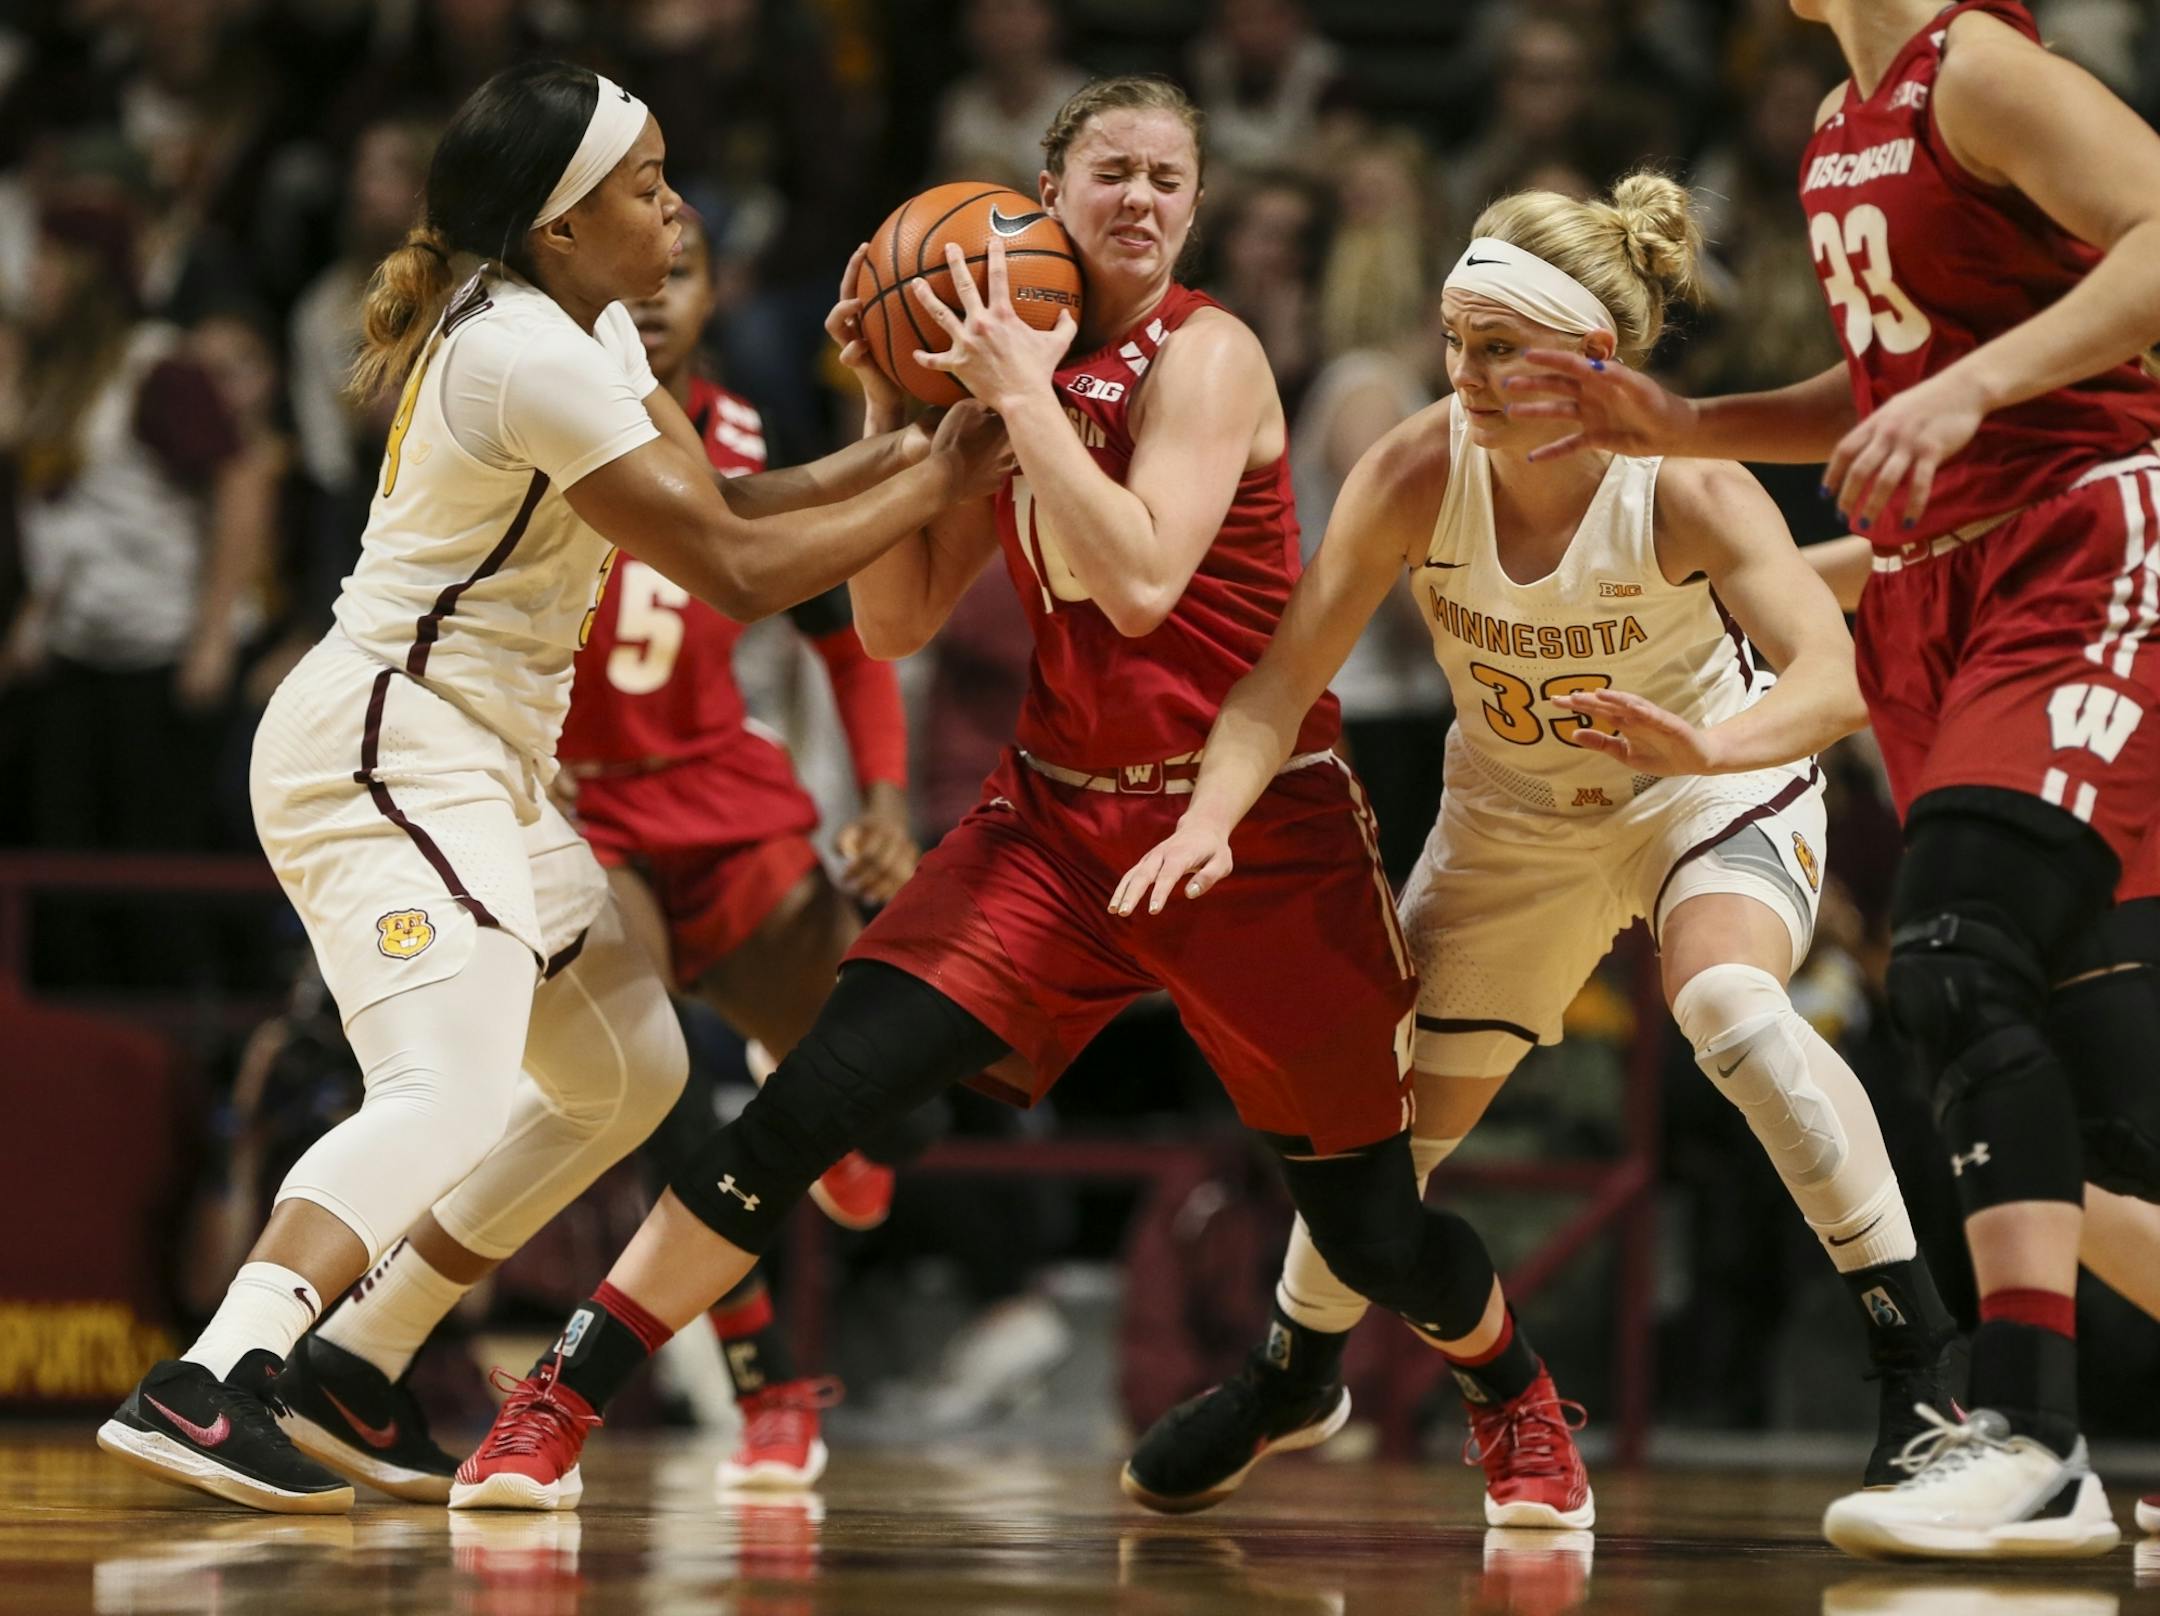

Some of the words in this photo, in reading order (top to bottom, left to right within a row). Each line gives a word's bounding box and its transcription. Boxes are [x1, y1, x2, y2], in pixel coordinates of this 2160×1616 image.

[1810, 203, 1932, 359] 33
[605, 560, 690, 695] 5
[1429, 584, 1649, 660] MINNESOTA
[1469, 661, 1621, 749] 33
[2045, 681, 2145, 765] W
